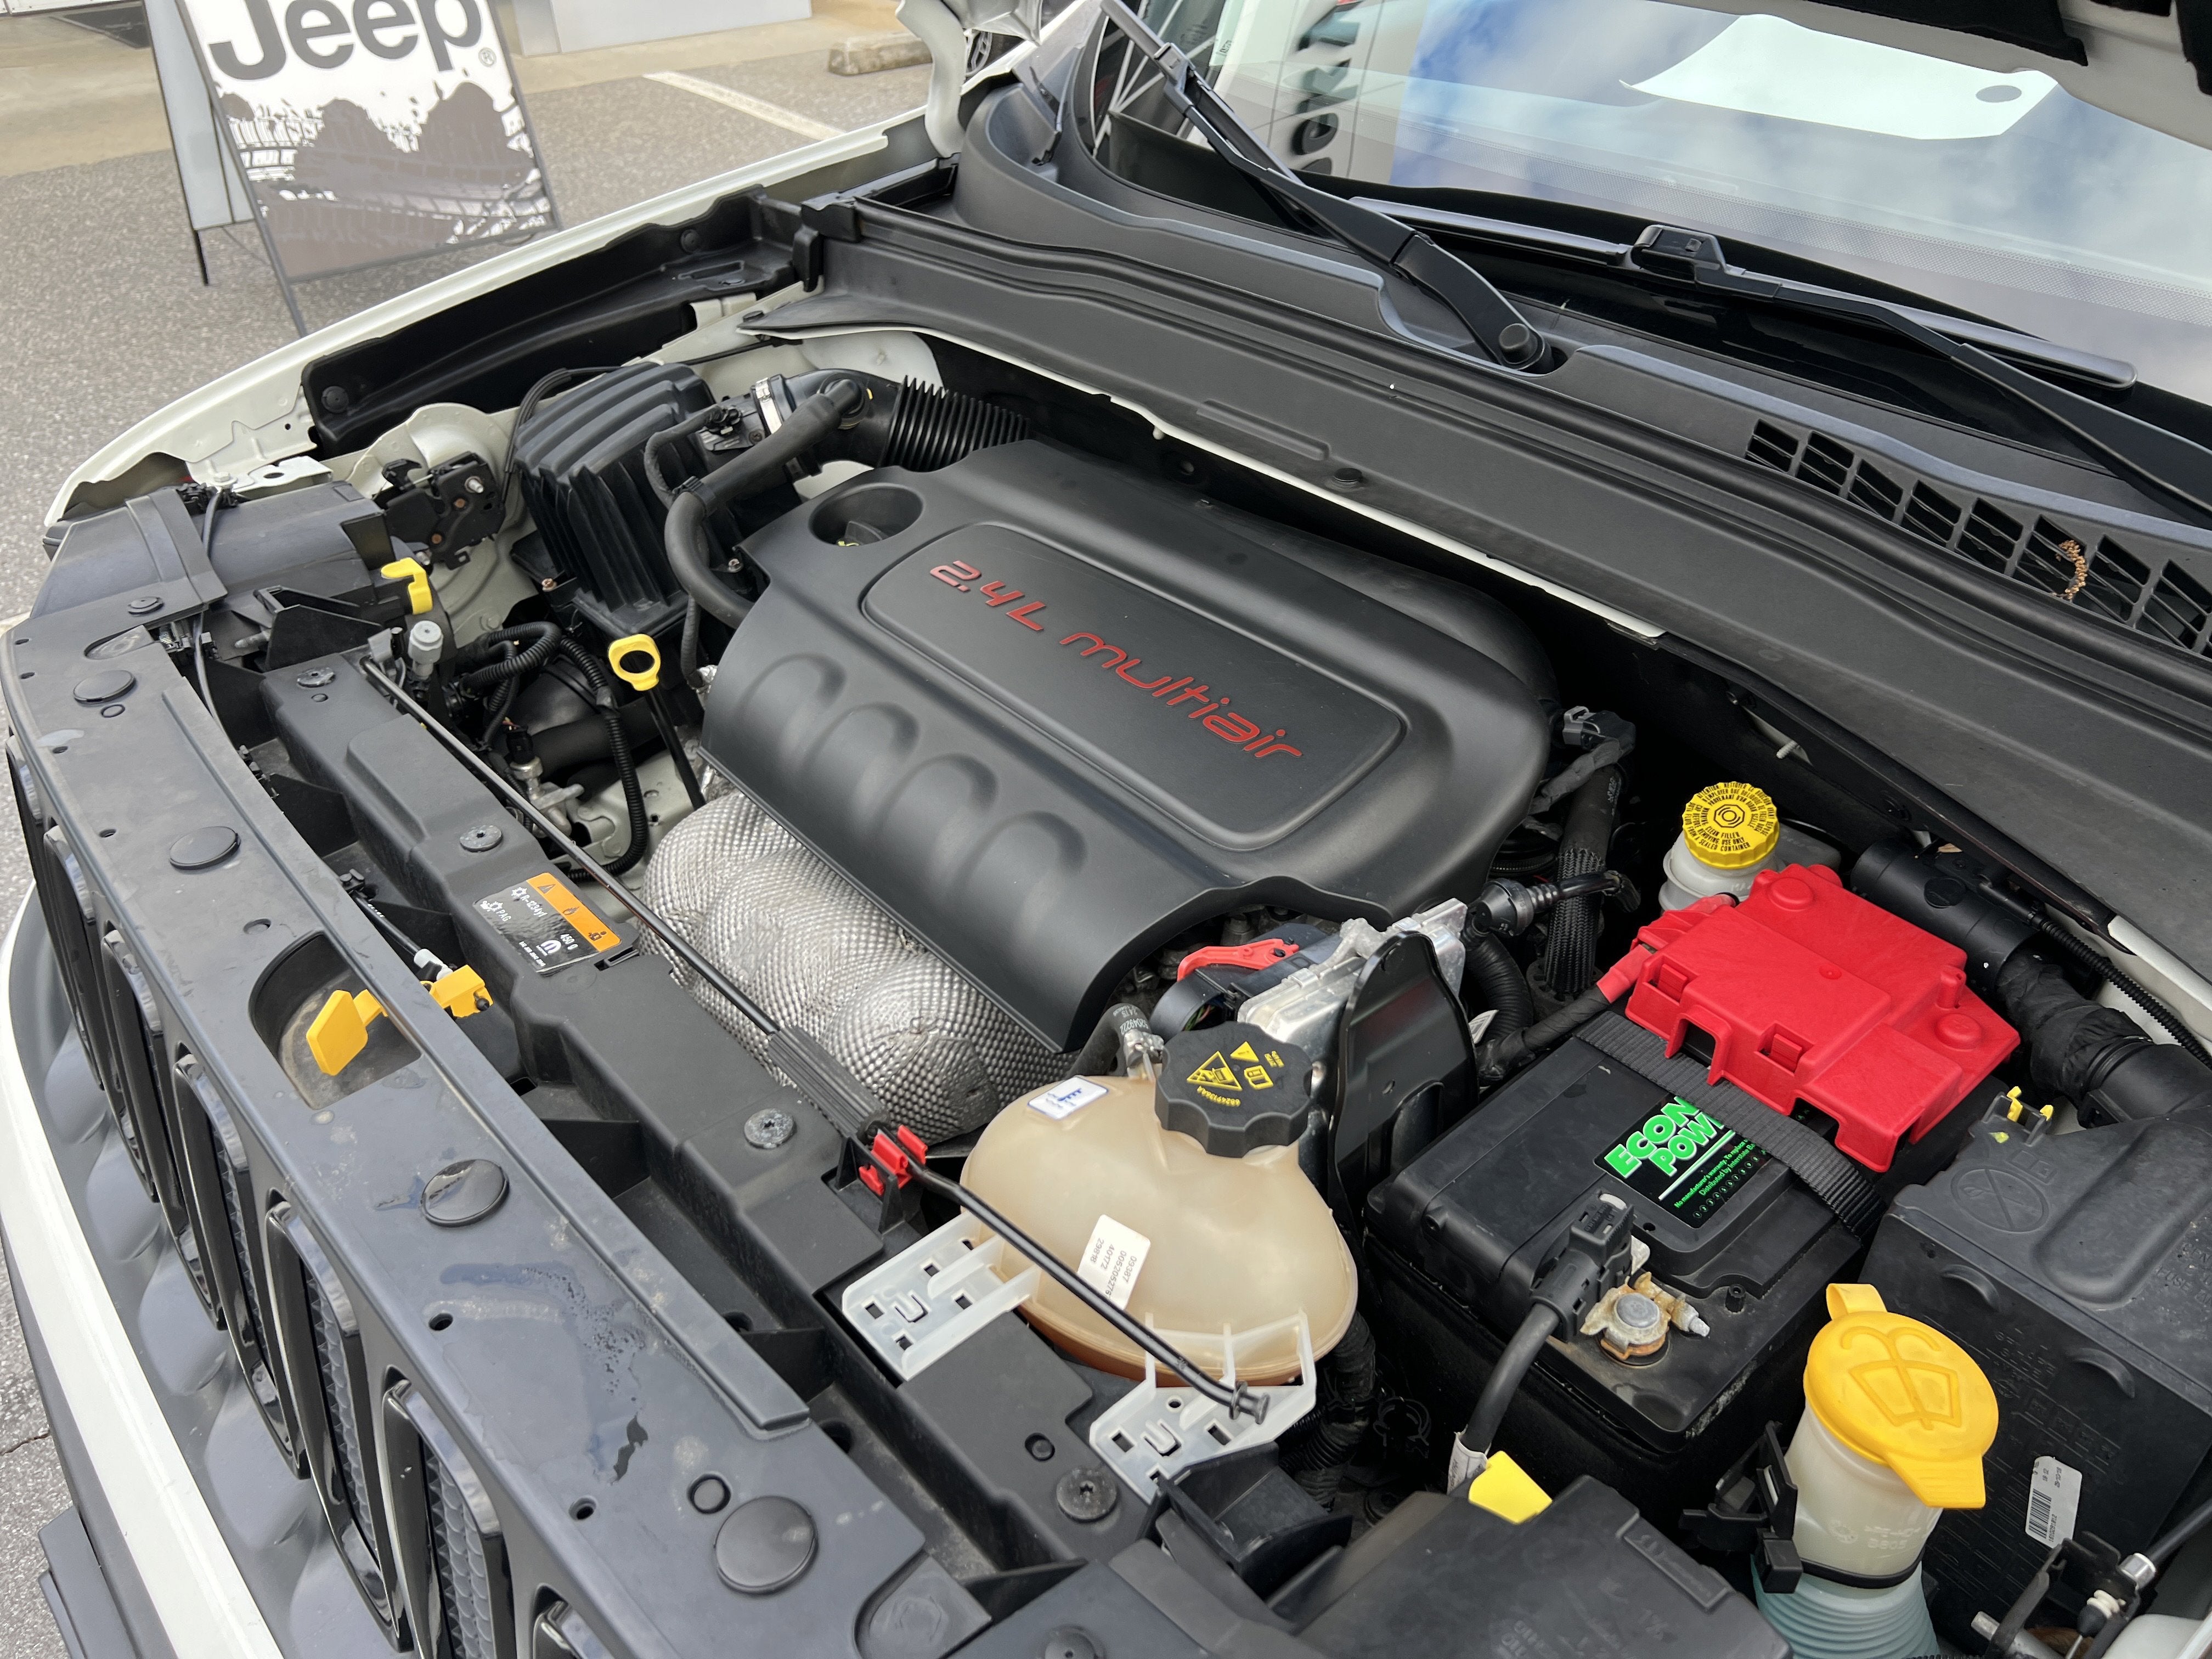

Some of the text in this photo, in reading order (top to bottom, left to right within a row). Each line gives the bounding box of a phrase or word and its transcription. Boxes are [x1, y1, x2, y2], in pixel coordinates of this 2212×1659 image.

[209, 0, 483, 81] Jeep
[929, 560, 1303, 758] 2.4L multiair
[1720, 842, 1751, 851] CONTAINER
[496, 907, 511, 922] PAG
[1699, 1171, 1725, 1195] Distributed
[1101, 1244, 1115, 1269] 40172
[1122, 1256, 1137, 1283] 09387
[1105, 1251, 1126, 1297] 005205276
